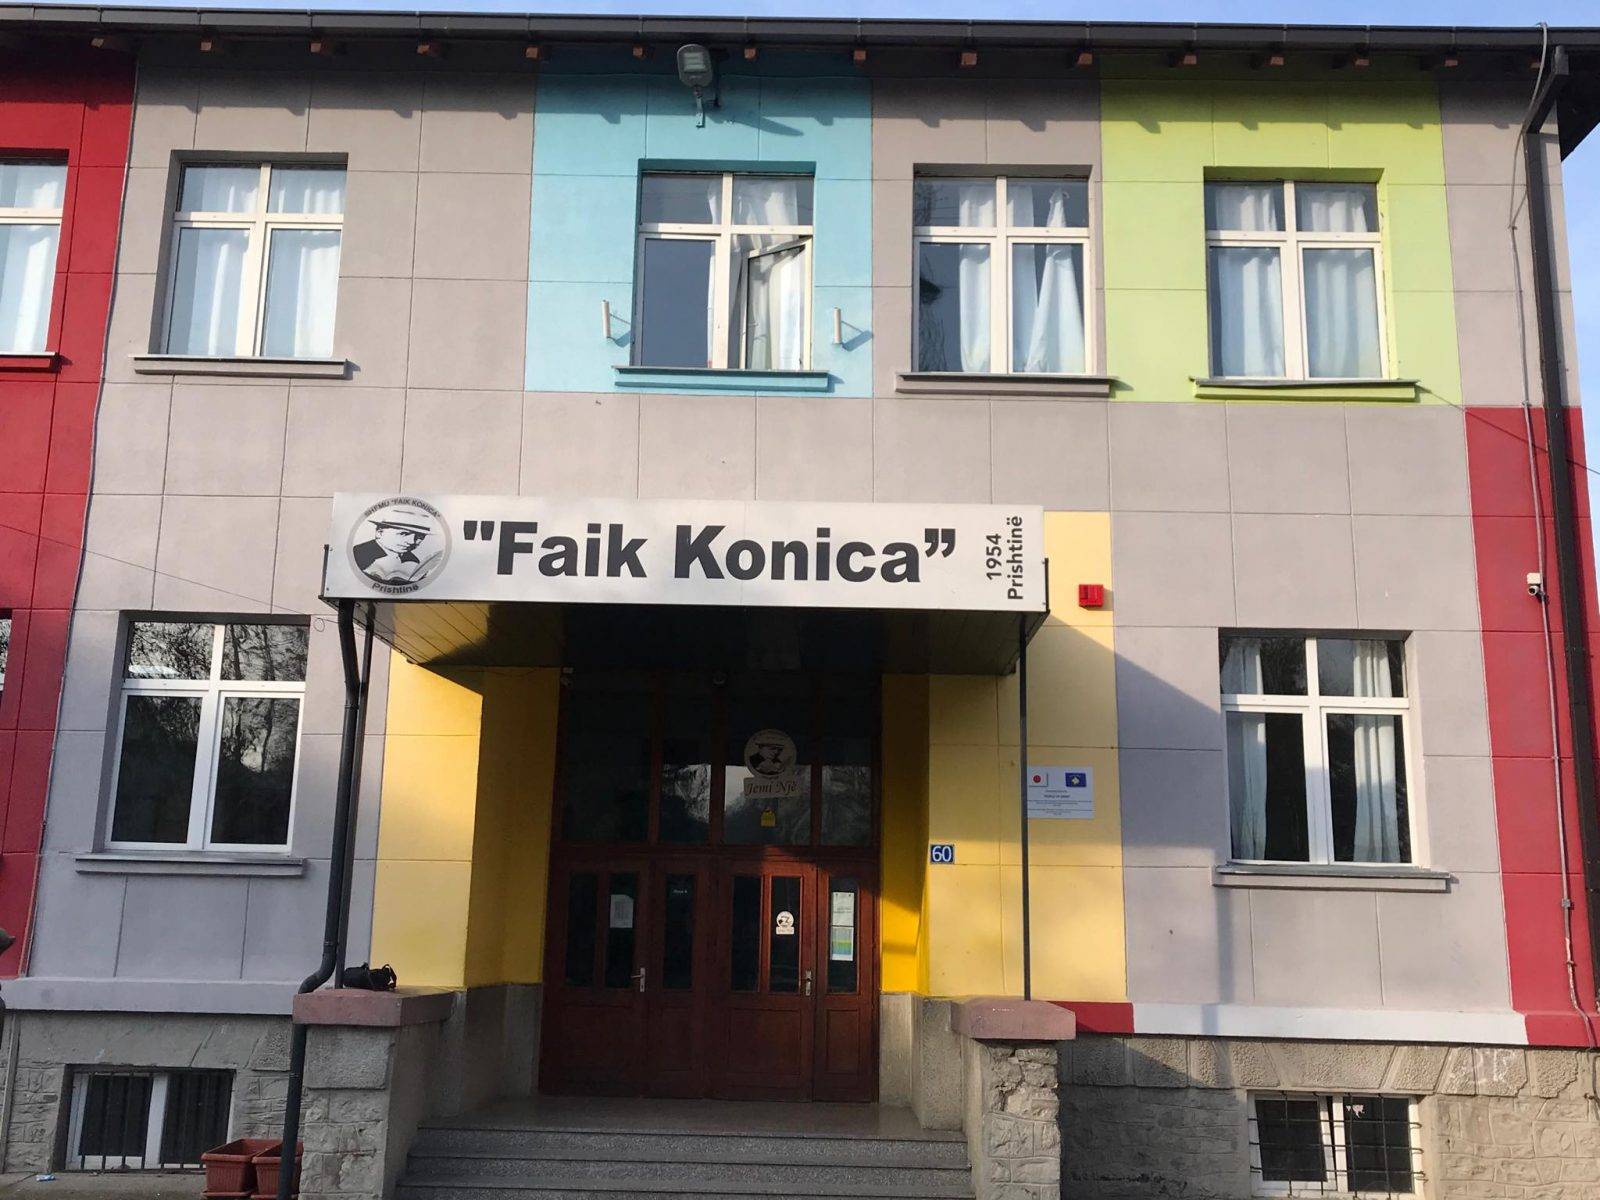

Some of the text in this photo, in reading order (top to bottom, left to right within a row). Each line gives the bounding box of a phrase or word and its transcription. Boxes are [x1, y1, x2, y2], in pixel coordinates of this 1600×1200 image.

[463, 520, 956, 583] "Faik Konica”
[986, 533, 1002, 581] 1954
[1006, 515, 1024, 600] Prishtinë
[932, 845, 952, 862] 60
